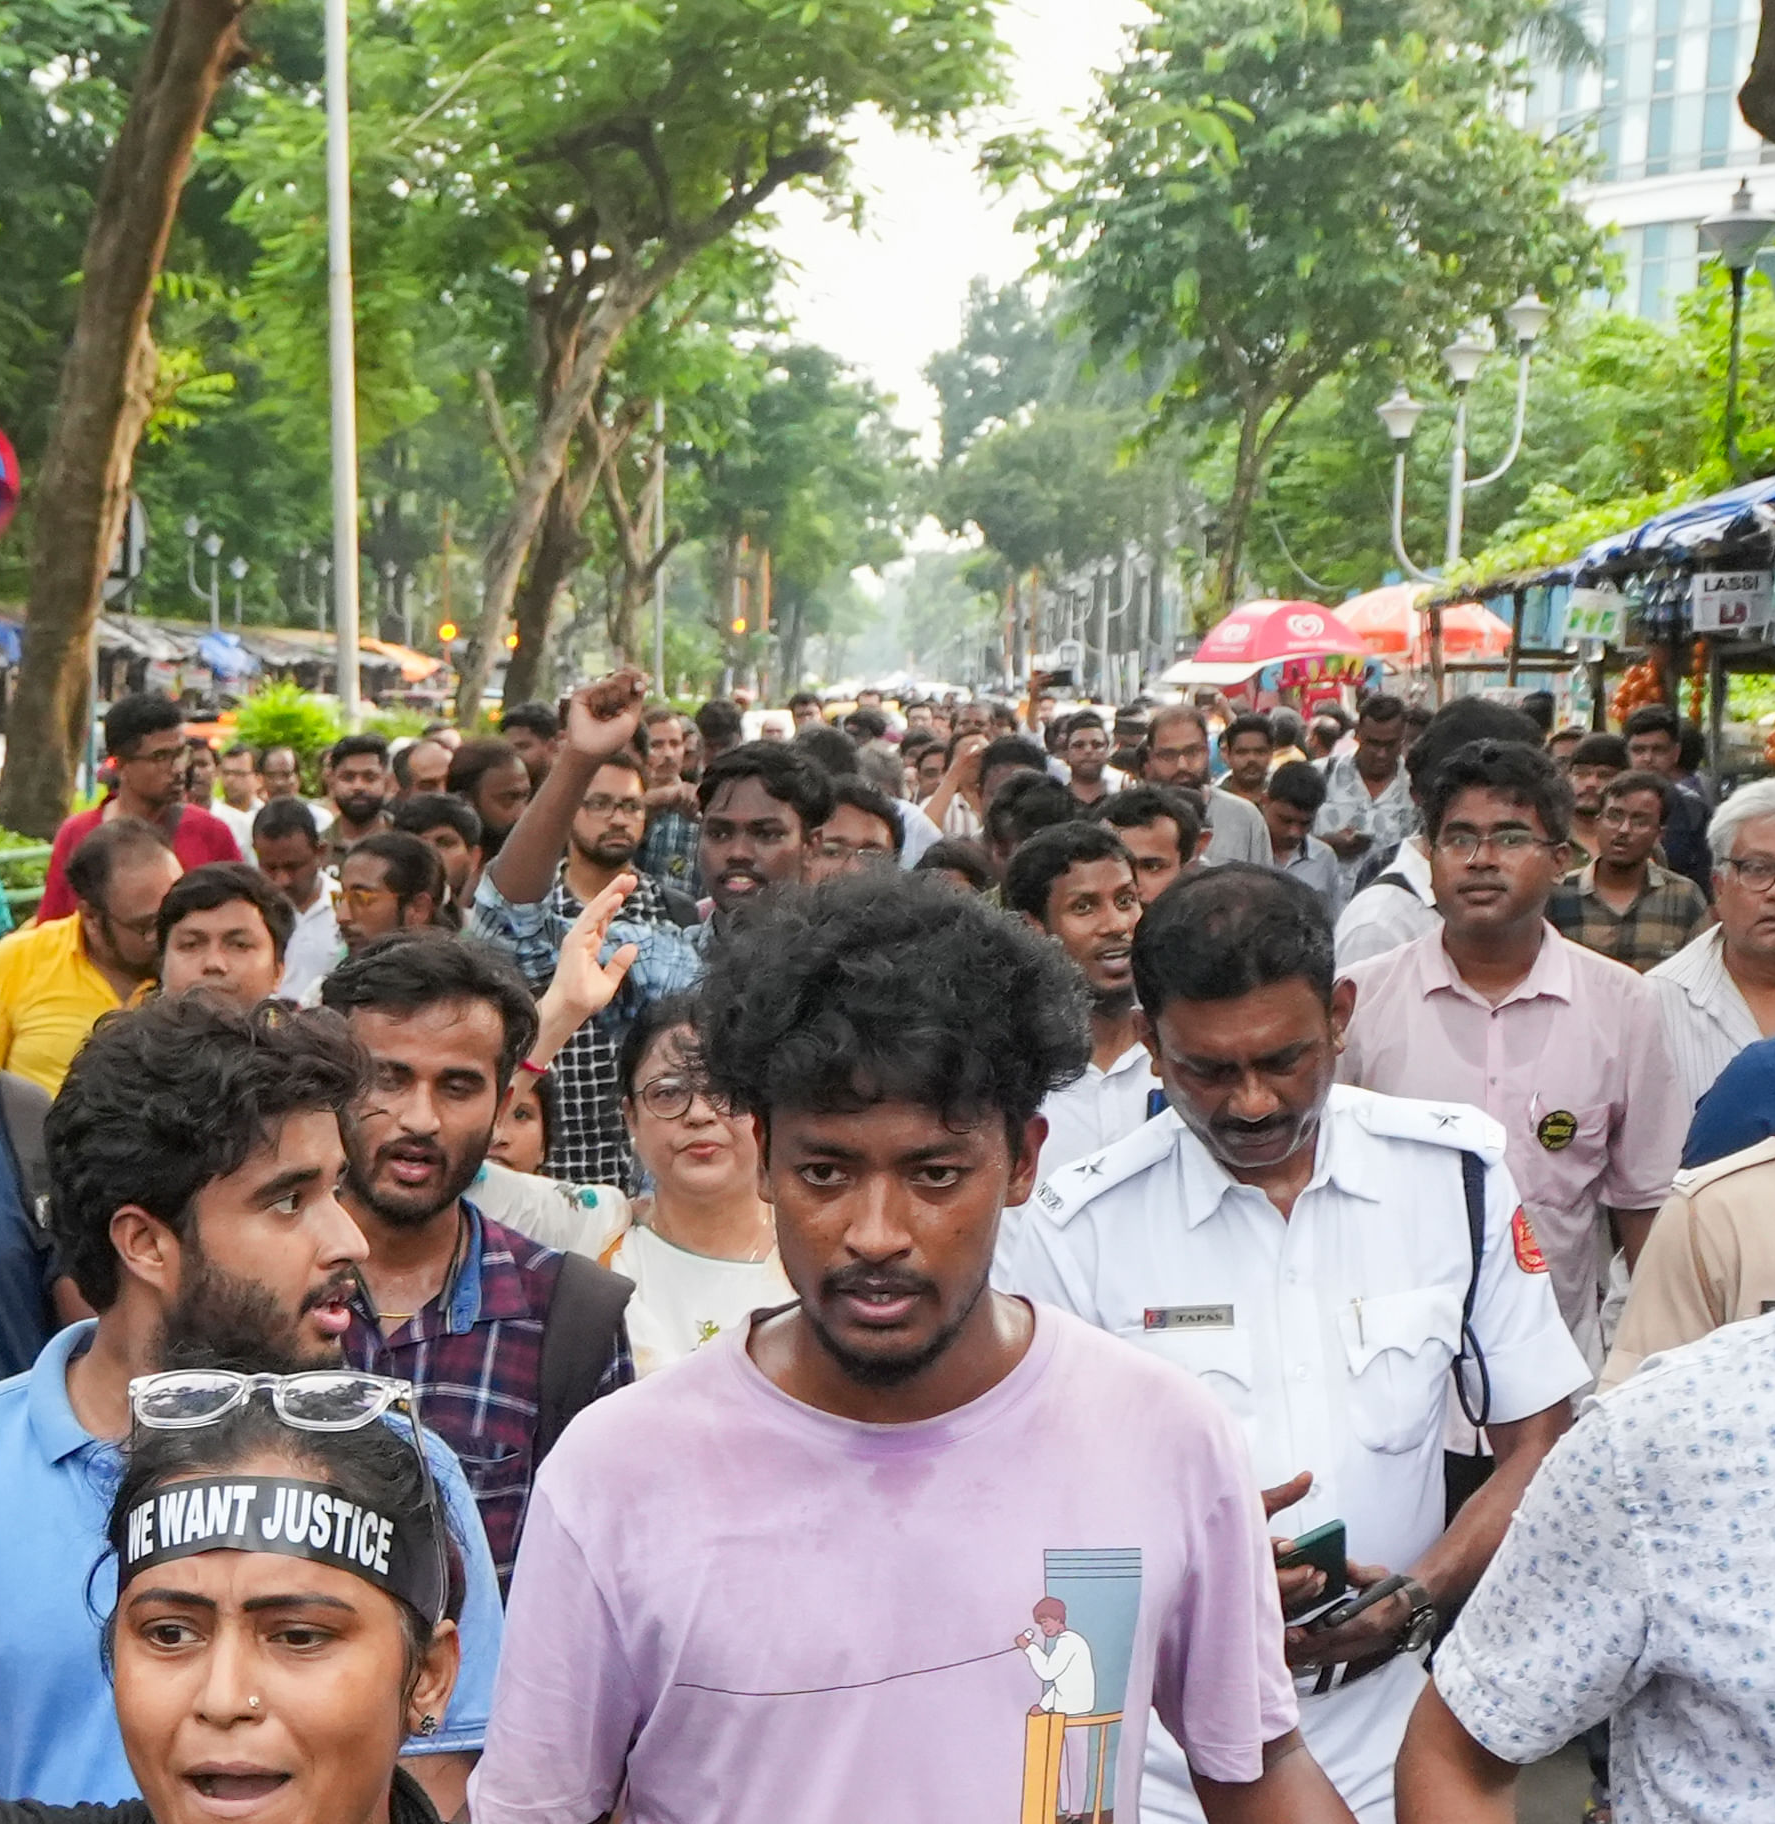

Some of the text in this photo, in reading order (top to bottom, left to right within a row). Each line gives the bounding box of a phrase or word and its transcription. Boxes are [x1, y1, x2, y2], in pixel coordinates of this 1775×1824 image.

[1704, 575, 1759, 592] LASSI
[1175, 1312, 1224, 1324] TAPAS
[128, 1485, 395, 1576] WE WANT JUSTICE
